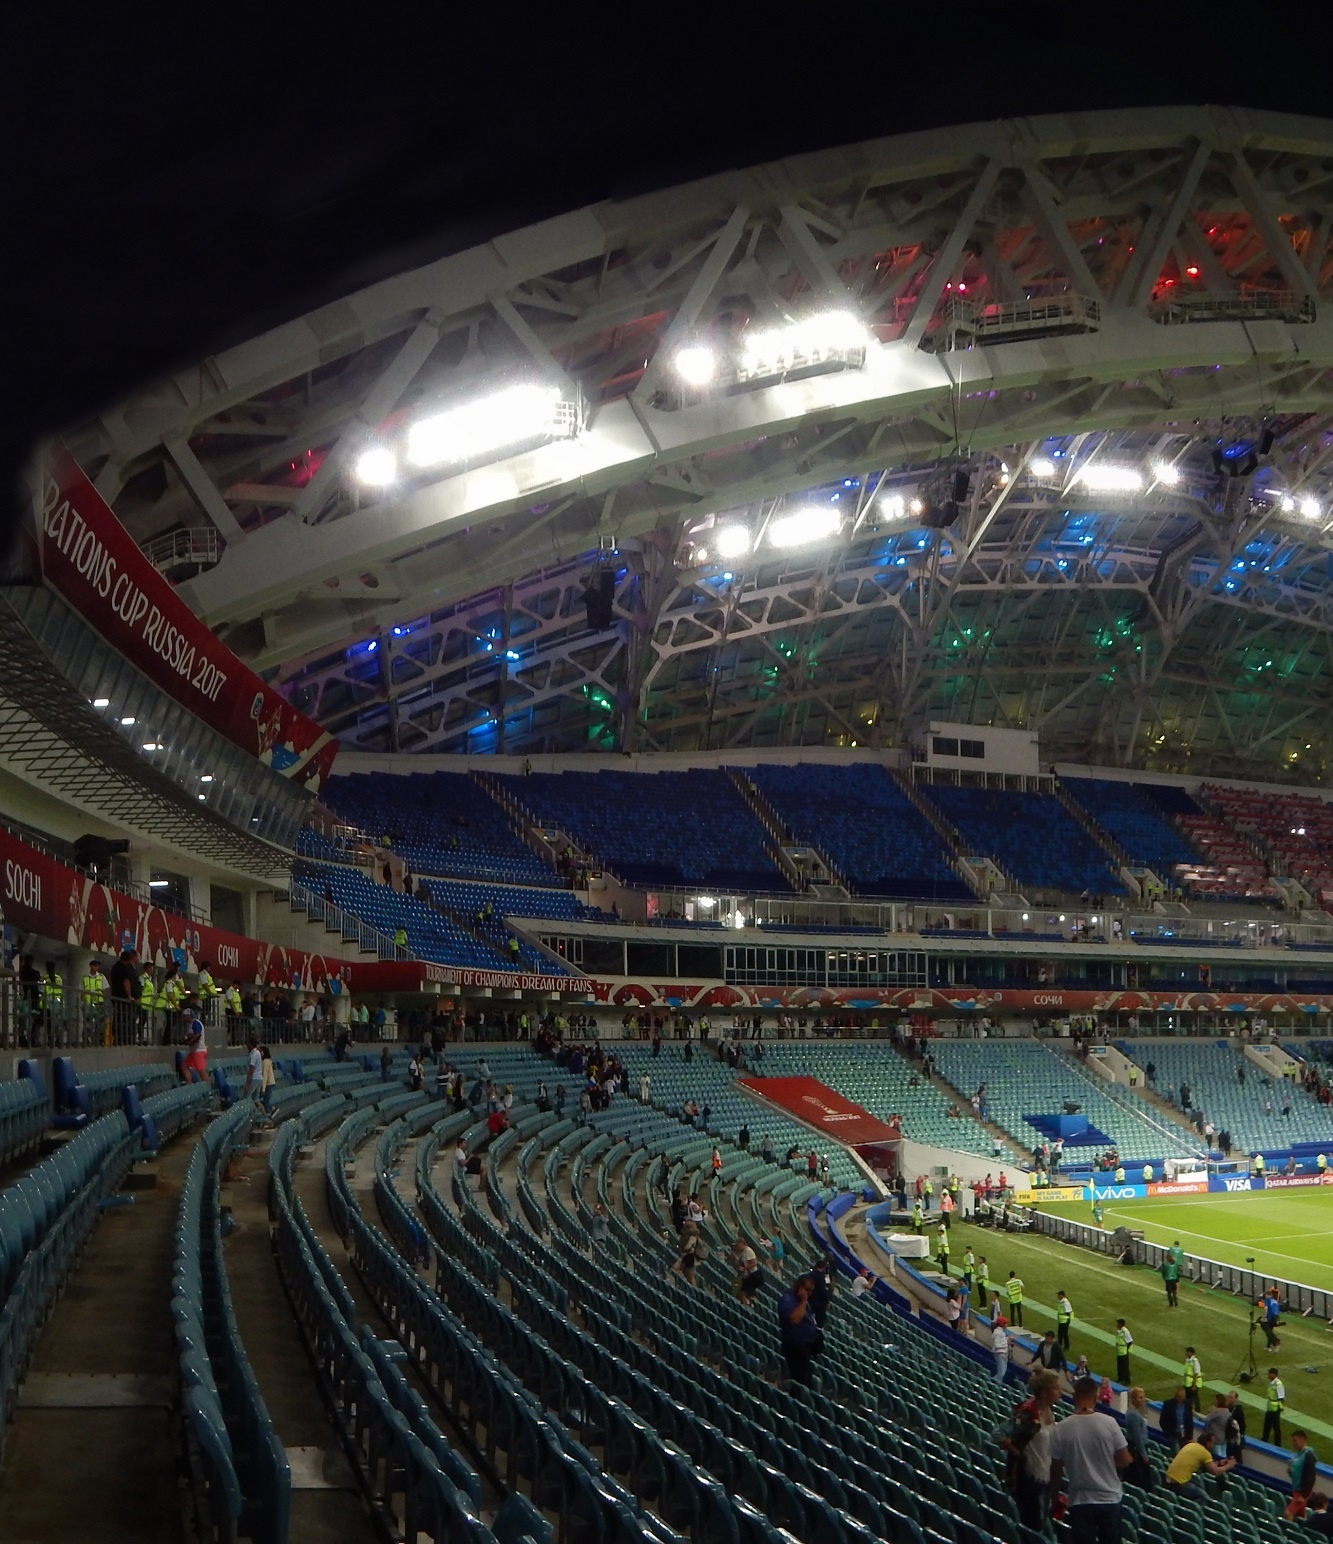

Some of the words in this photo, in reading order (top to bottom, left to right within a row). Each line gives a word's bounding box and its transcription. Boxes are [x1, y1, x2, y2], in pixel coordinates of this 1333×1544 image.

[111, 572, 149, 628] CUP
[142, 605, 196, 681] RUSSIA
[191, 656, 227, 702] 2017
[5, 858, 41, 911] SOCHI
[218, 943, 239, 968] СОЧИ
[463, 970, 474, 986] OF
[521, 976, 554, 991] DREAM
[556, 978, 567, 991] OF
[1033, 995, 1063, 1005] СОЧИ
[1157, 1185, 1198, 1193] McDonald's
[1224, 1179, 1252, 1191] VISA
[1267, 1180, 1287, 1188] QATAR
[1288, 1177, 1314, 1186] AIRWAYS
